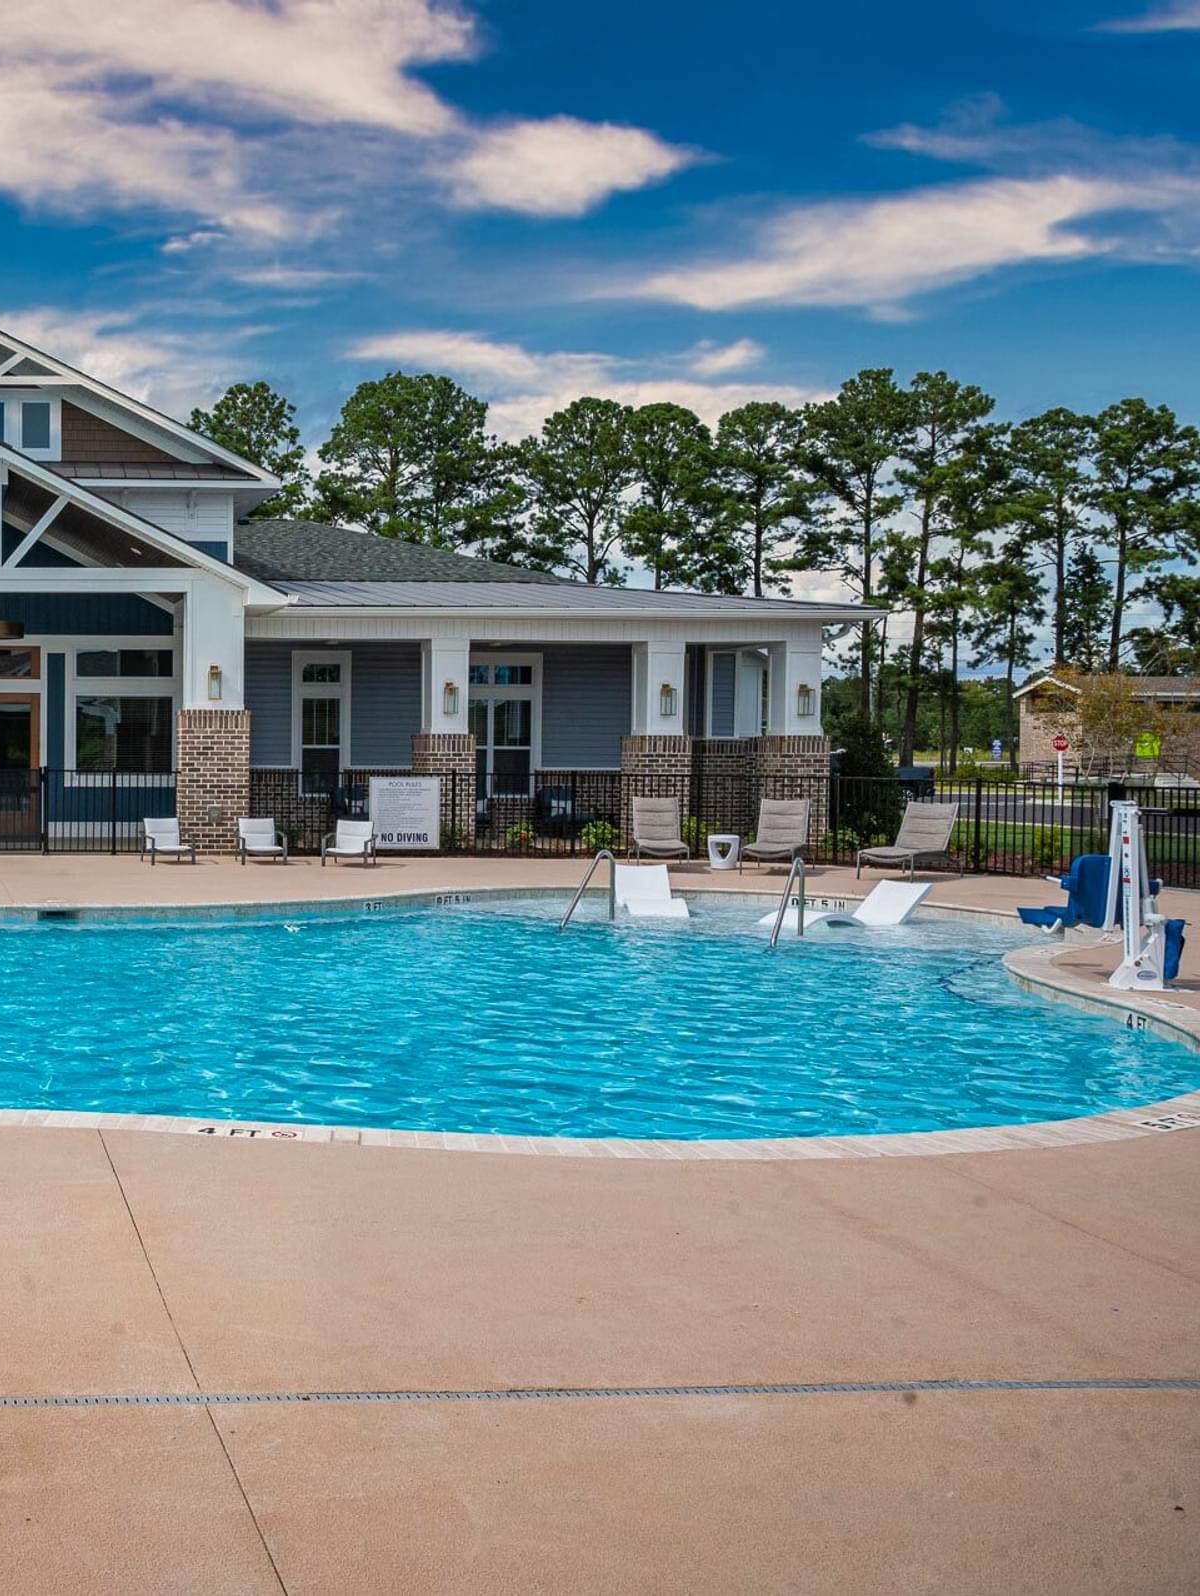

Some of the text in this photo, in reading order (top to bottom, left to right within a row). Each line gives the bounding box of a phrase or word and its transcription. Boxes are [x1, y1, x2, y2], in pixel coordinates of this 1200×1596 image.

[381, 832, 429, 843] NO DIVING
[444, 896, 453, 904] FT
[454, 896, 460, 904] 5
[462, 896, 471, 904] IN
[821, 900, 829, 908] 5
[833, 901, 845, 910] IN
[373, 902, 383, 912] FT
[1126, 1013, 1147, 1031] 4 FT
[229, 1128, 262, 1138] FT
